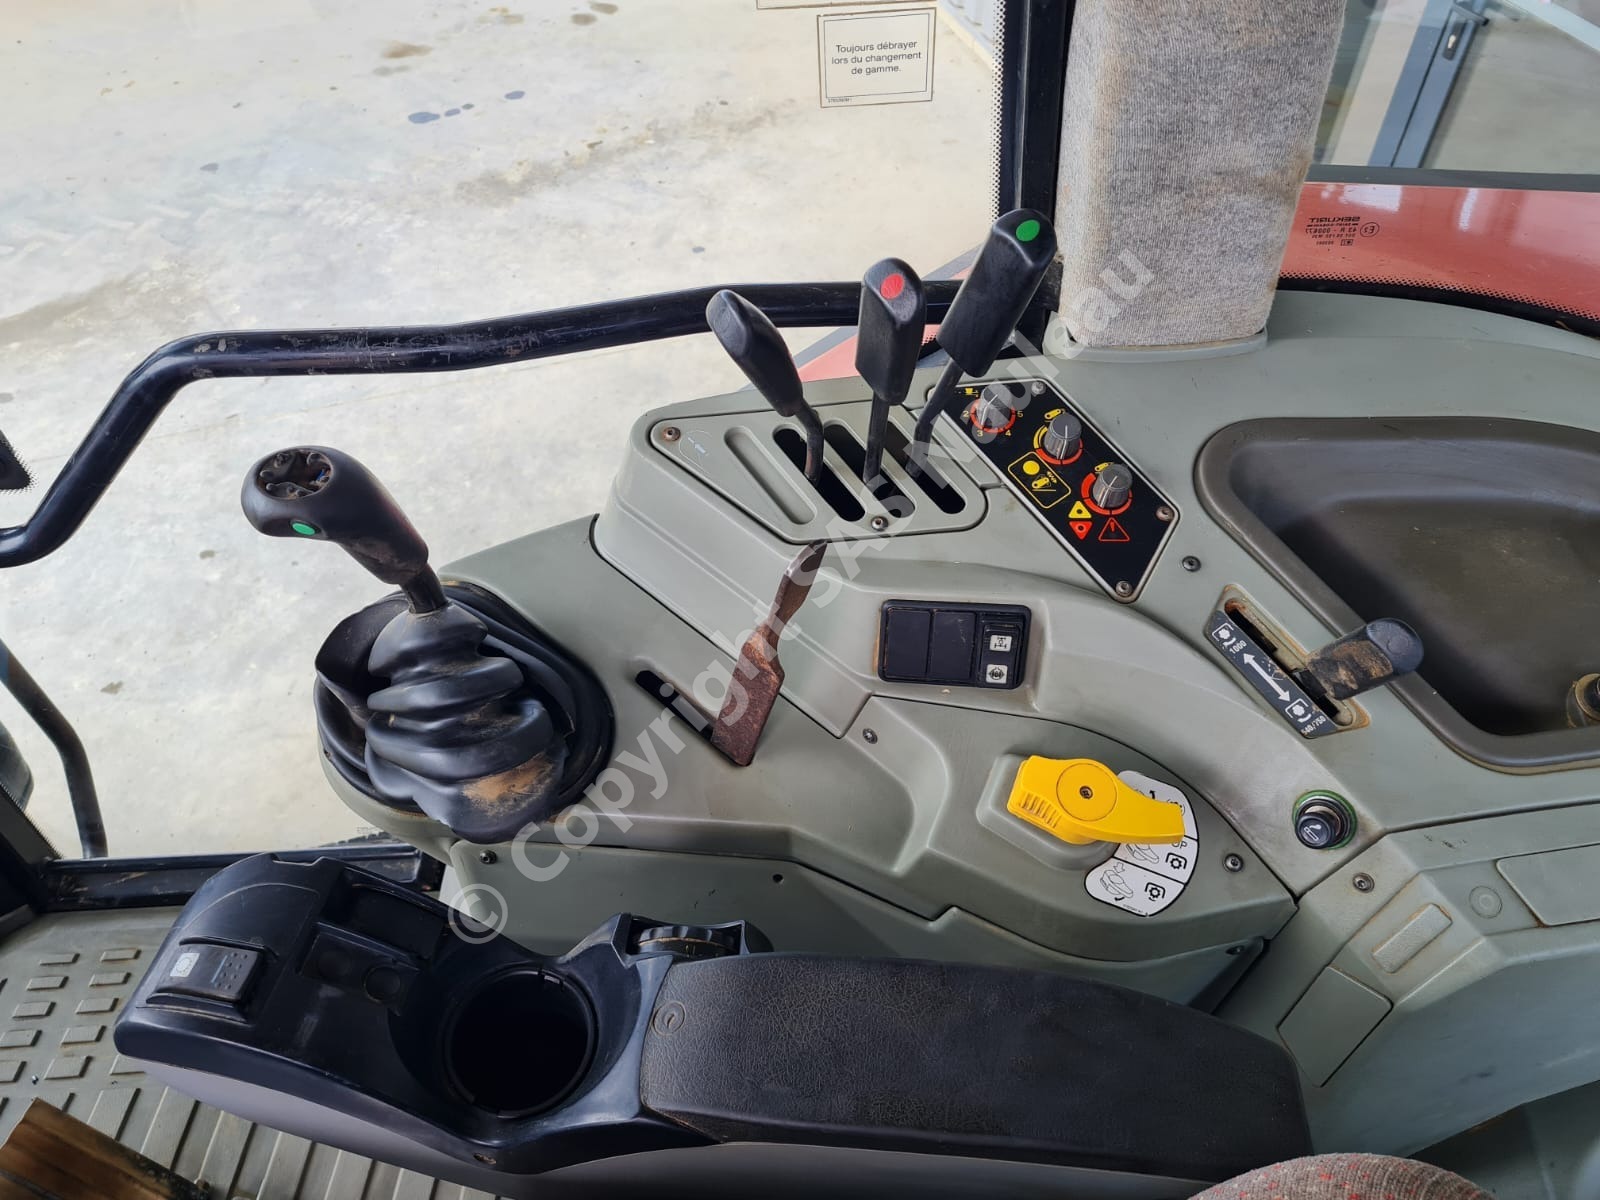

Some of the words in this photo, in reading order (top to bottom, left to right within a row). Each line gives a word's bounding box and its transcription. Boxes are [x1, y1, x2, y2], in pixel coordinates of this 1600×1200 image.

[836, 44, 874, 53] Toujours
[877, 41, 917, 50] débrayer
[831, 56, 849, 65] lors
[850, 55, 863, 64] du
[865, 51, 922, 62] changement
[851, 66, 863, 75] de
[865, 65, 901, 75] gamme.
[962, 410, 970, 418] 2
[1017, 410, 1024, 418] 5
[976, 429, 984, 437] 3
[1005, 429, 1012, 437] 4
[1229, 640, 1247, 654] 1000
